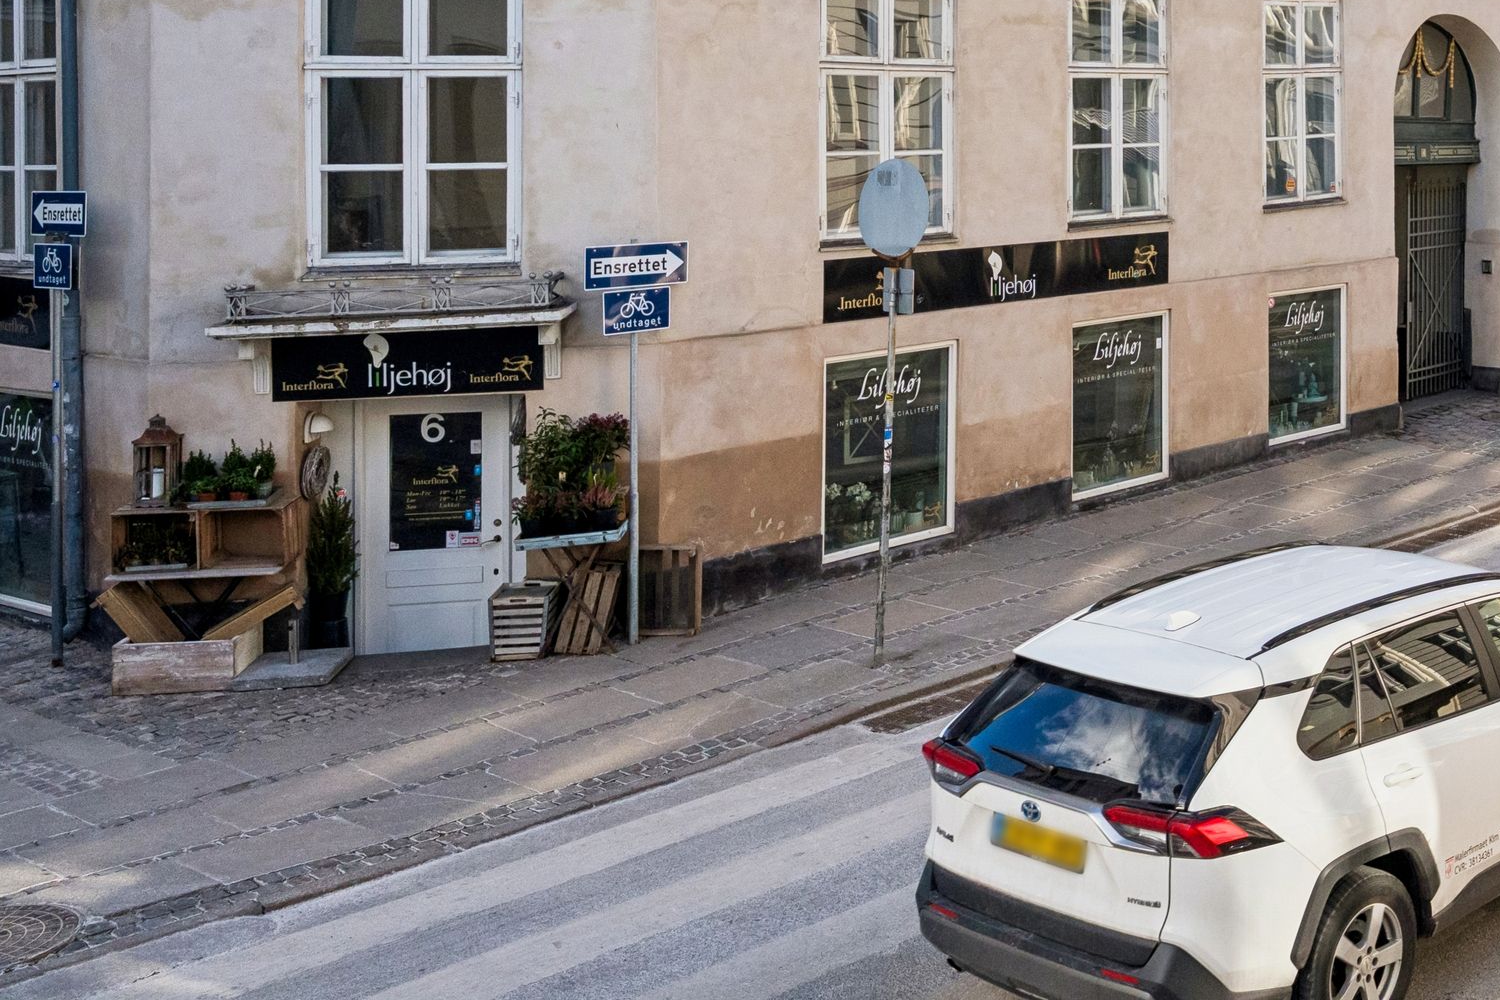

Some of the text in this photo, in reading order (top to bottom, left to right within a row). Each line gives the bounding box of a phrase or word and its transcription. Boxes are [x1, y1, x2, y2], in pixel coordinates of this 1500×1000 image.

[42, 206, 82, 221] Ensrettet
[593, 257, 667, 275] Ensrettet
[1108, 267, 1147, 281] Interflora
[38, 275, 66, 285] undtaget
[990, 273, 1036, 302] liljehøj
[838, 291, 883, 312] Interflo
[613, 316, 661, 330] undtaget
[1284, 300, 1325, 334] Liljehøj
[1093, 330, 1142, 369] Liljehøj
[282, 380, 334, 392] Interflora
[368, 361, 453, 395] liljehøj
[469, 372, 519, 384] Interflora
[0, 405, 41, 454] Liljehøj
[421, 413, 445, 443] 6
[413, 477, 449, 486] Interflora
[1454, 840, 1488, 860] Malerfirmaet
[1489, 834, 1499, 844] Kim
